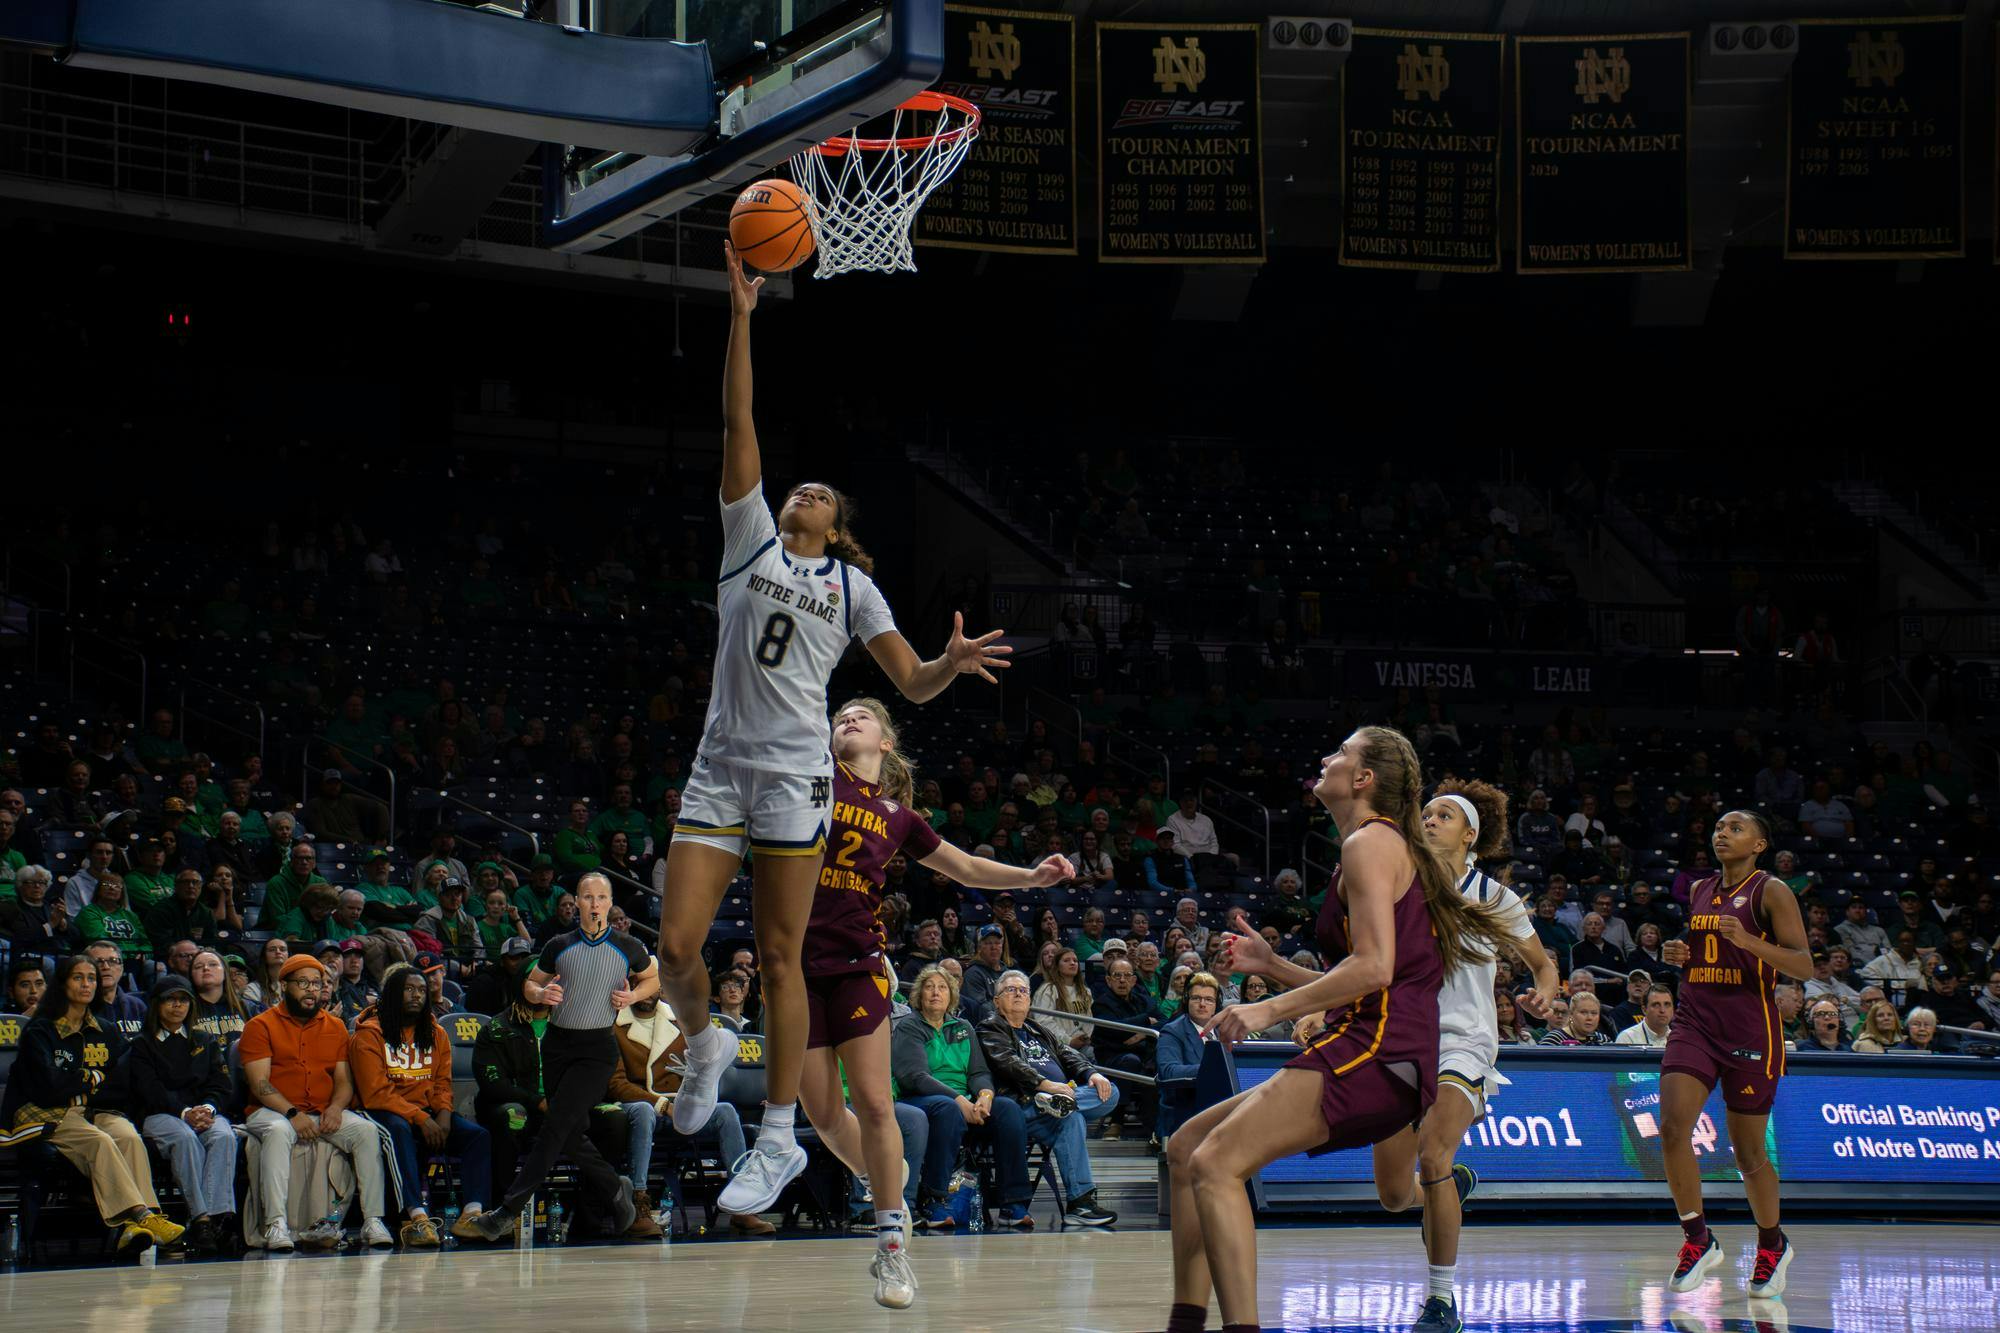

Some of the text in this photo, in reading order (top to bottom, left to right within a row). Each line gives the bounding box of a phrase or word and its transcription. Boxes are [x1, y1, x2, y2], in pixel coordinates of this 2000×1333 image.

[984, 87, 1059, 106] EAST
[1841, 97, 1913, 113] NCAA
[1169, 100, 1244, 117] EAST
[1392, 108, 1453, 128] NCAA
[1571, 112, 1637, 130] NCAA
[1816, 119, 1936, 139] SWEET 16
[1004, 126, 1065, 148] SEASON
[1107, 137, 1252, 156] TOURNAMENT
[1350, 129, 1496, 153] TOURNAMENT
[1527, 133, 1683, 156] TOURNAMENT
[1127, 158, 1235, 176] CHAMPION
[1529, 163, 1560, 177] 2020
[1111, 183, 1140, 196] 1995
[1149, 183, 1177, 196] 1996
[1187, 183, 1215, 197] 1997
[1109, 199, 1140, 211] 2000
[1148, 199, 1176, 212] 2001
[1186, 199, 1216, 212] 2002
[924, 215, 1068, 241] WOMEN'S VOLLEYBALL
[1109, 213, 1140, 226] 2005
[1109, 232, 1258, 250] WOMEN'S VOLLEYBALL
[1794, 226, 1954, 246] WOMEN'S VOLLEYBALL
[1349, 236, 1492, 259] WOMEN'S VOLLEYBALL
[1528, 241, 1683, 262] WOMEN'S VOLLEYBALL
[746, 573, 837, 625] NOTRE DAME
[756, 611, 796, 669] 8
[1375, 661, 1478, 688] VANESSA
[1532, 665, 1592, 692] LEAH
[832, 801, 889, 840] ENTRAL
[835, 830, 863, 867] 2
[820, 867, 871, 896] CHIGAN
[1690, 914, 1720, 931] CENTR
[1705, 933, 1719, 964] 0
[1688, 967, 1743, 985] MICHIGAN
[1463, 1104, 1582, 1147] nion1
[1821, 1103, 1896, 1126] Official
[1897, 1104, 1987, 1133] Banking
[1833, 1136, 1855, 1157] of
[1857, 1137, 1917, 1158] Notre
[1917, 1137, 1980, 1160] Dame
